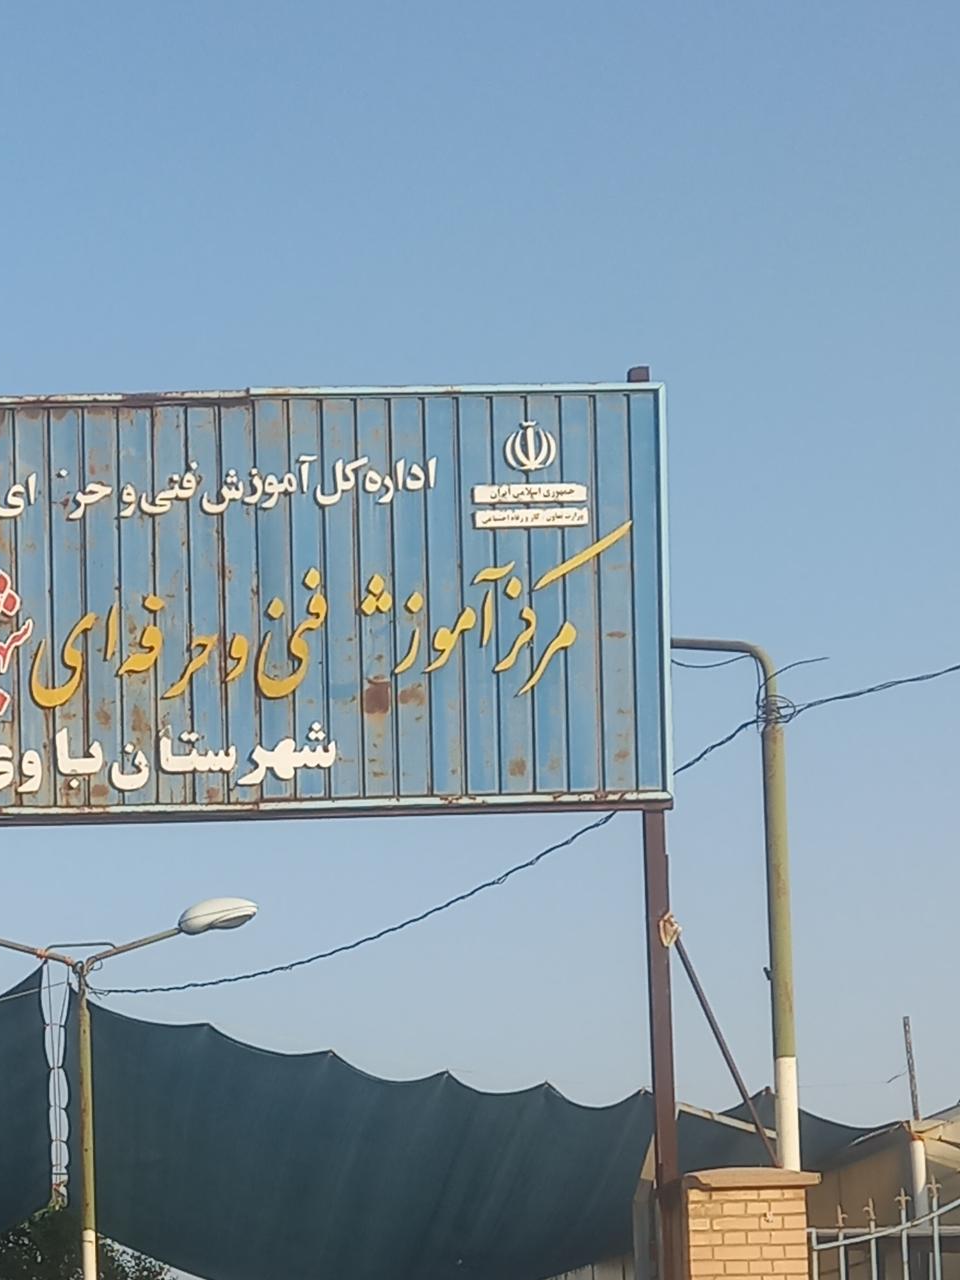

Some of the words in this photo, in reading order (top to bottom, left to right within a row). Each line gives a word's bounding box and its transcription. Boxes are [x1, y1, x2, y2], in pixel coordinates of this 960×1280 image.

[56, 468, 113, 520] حر
[119, 483, 138, 518] و
[139, 460, 199, 515] فنی
[201, 455, 319, 514] آموزش
[314, 456, 369, 505] کل
[363, 456, 437, 503] اداره
[489, 486, 512, 500] ایران
[512, 486, 542, 500] اسلامی
[542, 486, 576, 500] جمهوری
[256, 567, 328, 699] فنی
[493, 519, 633, 697] مرکز
[29, 599, 120, 709] ای
[117, 593, 219, 700] حرفه
[224, 633, 249, 682] و
[109, 720, 337, 791] شهرستان
